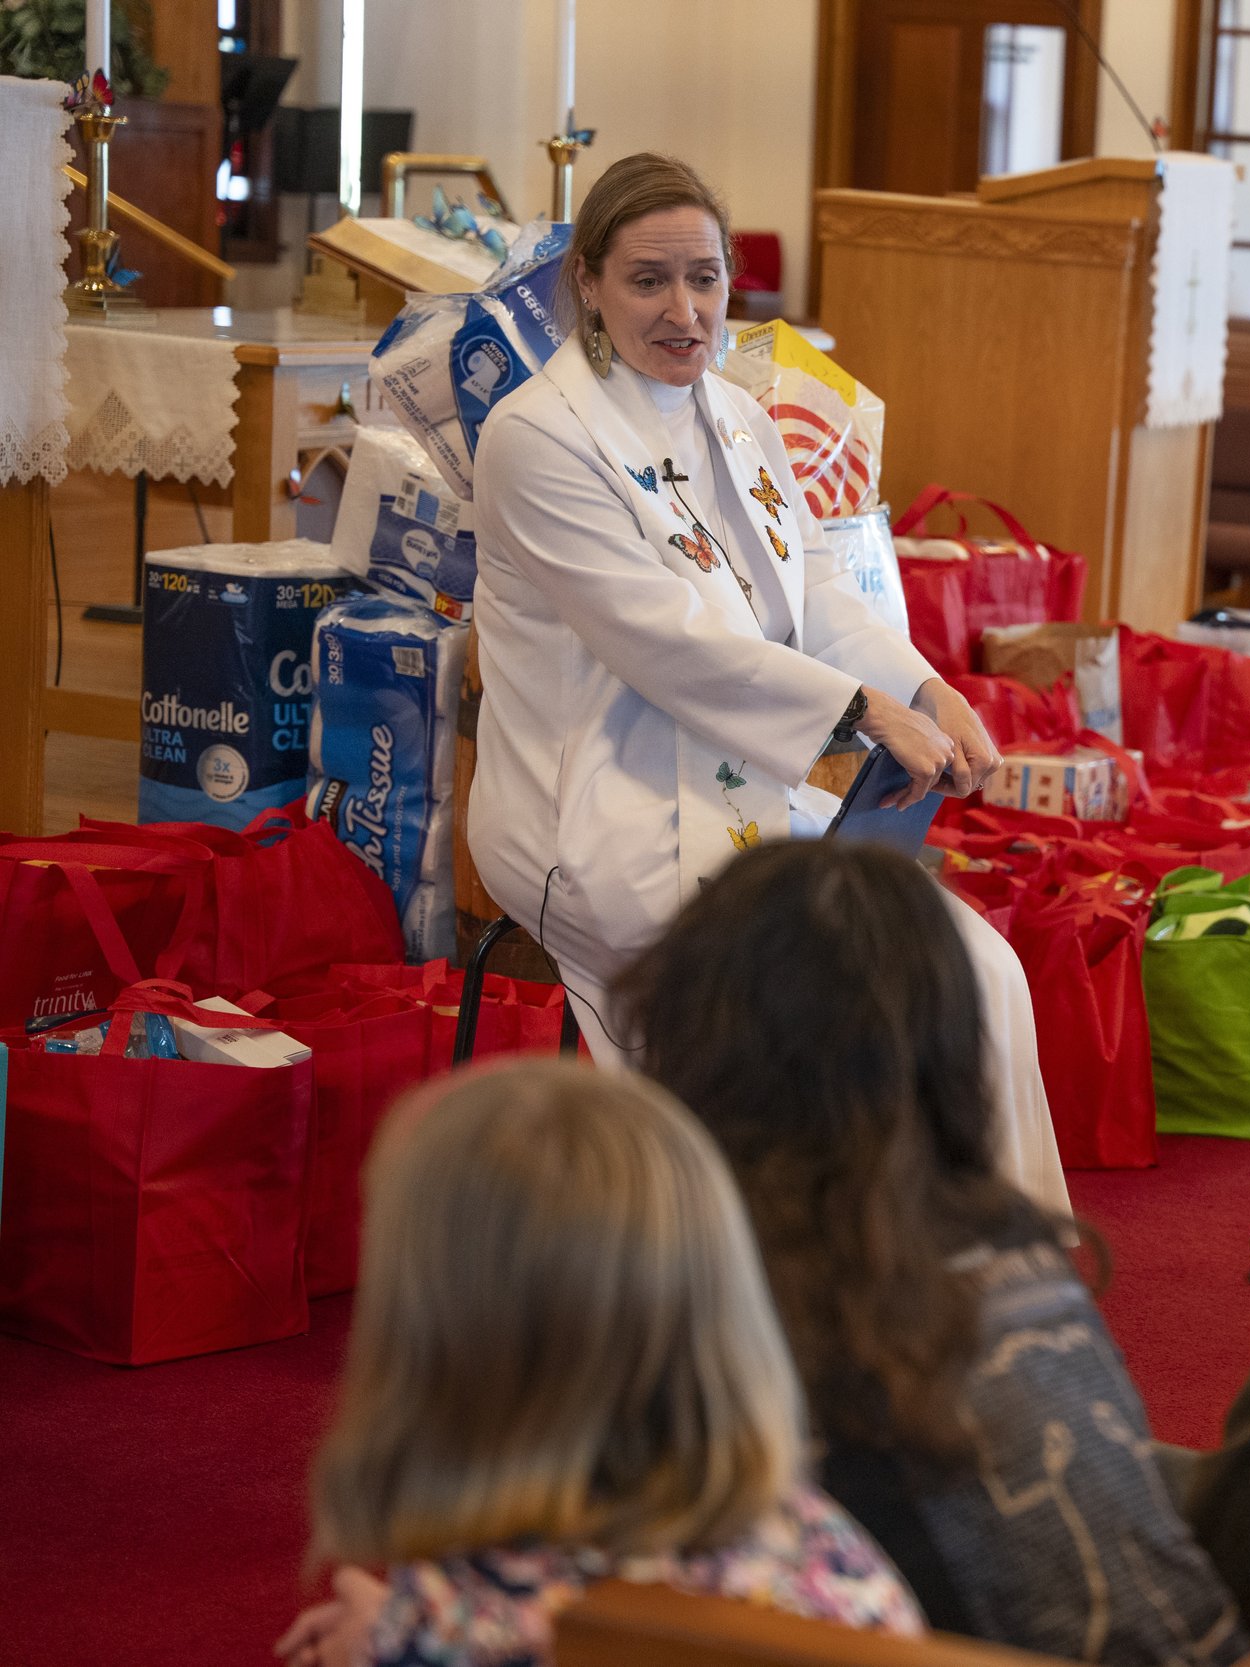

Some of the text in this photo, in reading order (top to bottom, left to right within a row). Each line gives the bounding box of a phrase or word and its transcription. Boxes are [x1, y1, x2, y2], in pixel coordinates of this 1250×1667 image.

[481, 343, 508, 372] SHEETS
[489, 342, 508, 362] WIDE
[142, 691, 249, 734] Cottonelle
[142, 727, 184, 746] ULTRA
[142, 743, 187, 763] CLEAN
[213, 758, 230, 773] 3x
[345, 724, 393, 836] Tissue
[392, 785, 408, 891] Soft and Absorbent
[33, 990, 91, 1017] trinity
